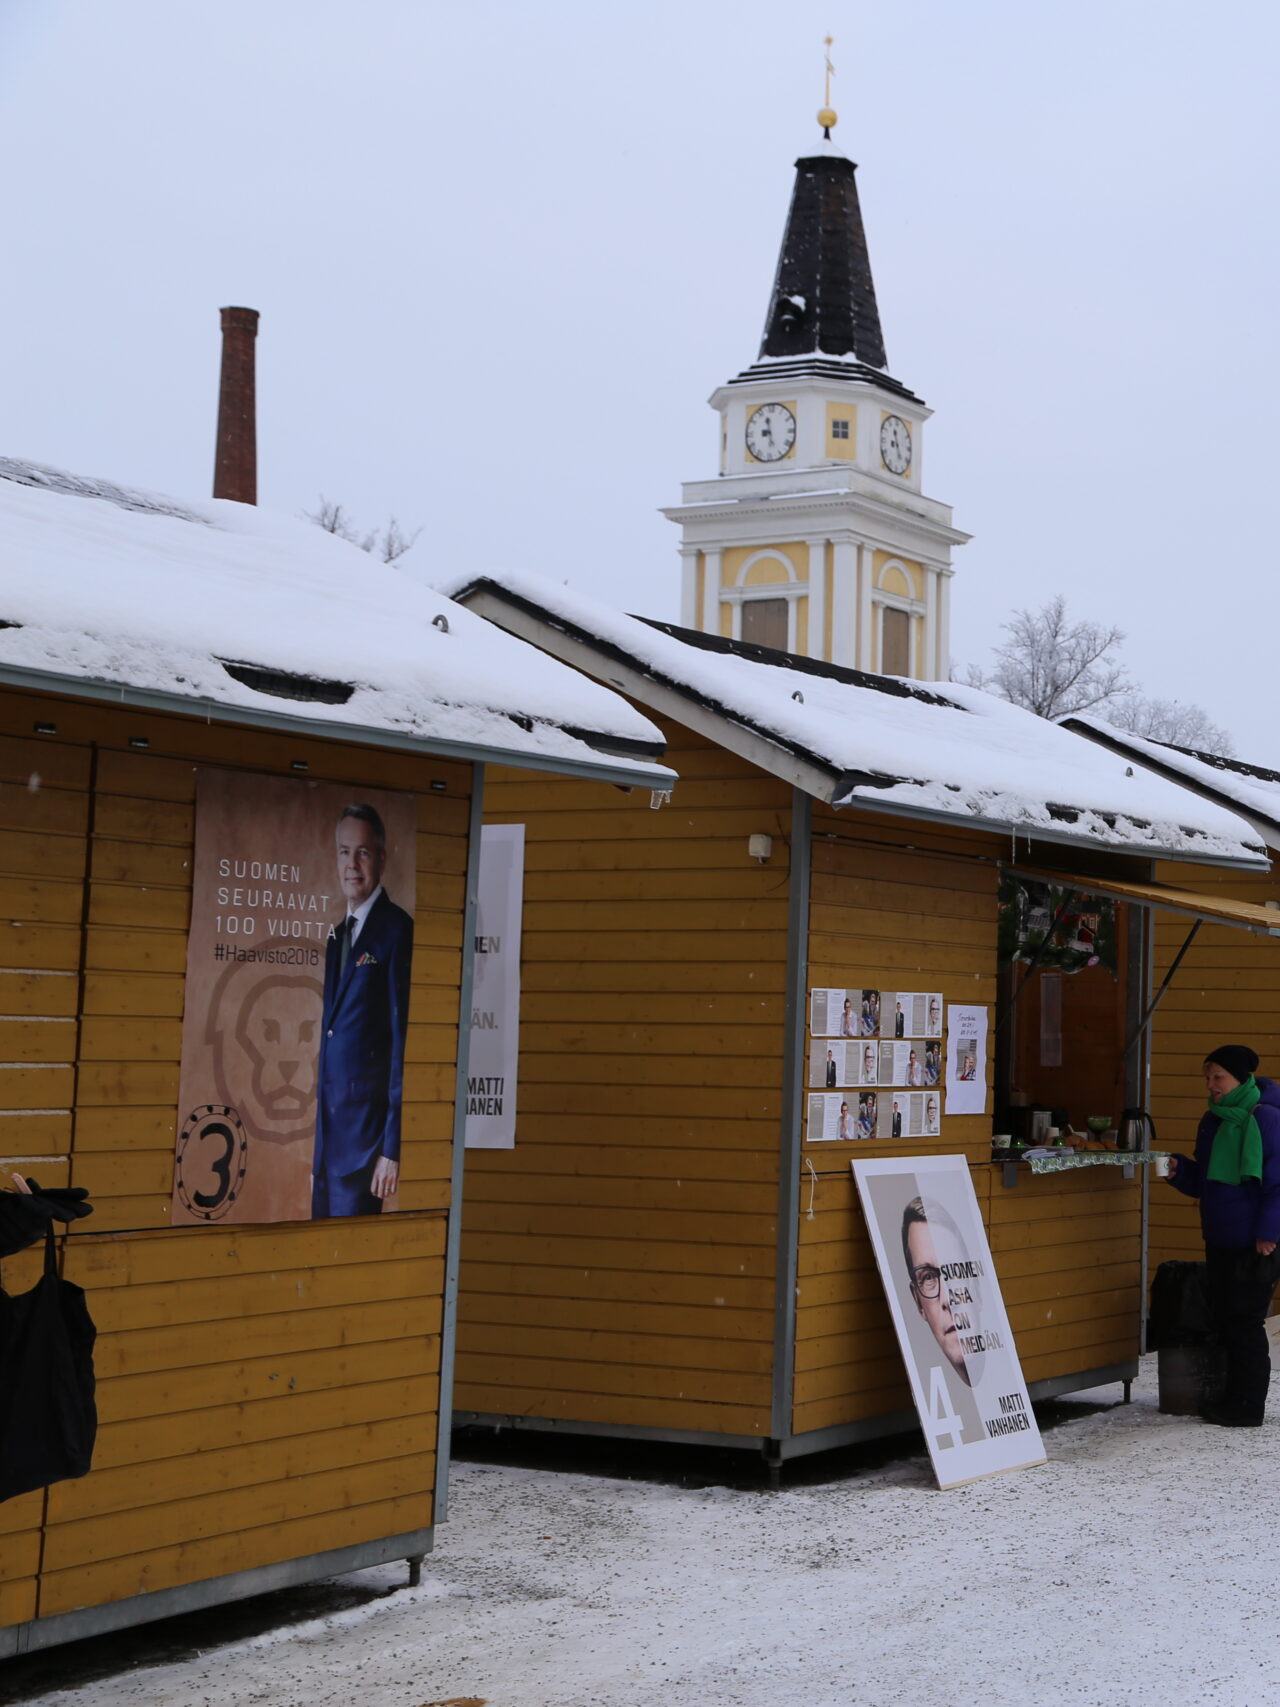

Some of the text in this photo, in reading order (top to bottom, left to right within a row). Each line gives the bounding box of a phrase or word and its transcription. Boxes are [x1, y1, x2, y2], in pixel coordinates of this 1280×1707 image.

[219, 859, 300, 883] SUOMEN
[217, 887, 330, 912] SEURAAVAT
[216, 916, 336, 940] 100 VUOTTA
[214, 943, 319, 966] #Haavisto2018
[467, 1077, 504, 1095] MATTI
[193, 1122, 235, 1208] 3
[940, 1260, 984, 1281] SUOMEN
[948, 1287, 974, 1306] ASIA
[953, 1312, 971, 1330] ON
[928, 1366, 964, 1451] 4
[998, 1392, 1025, 1414] MATTI
[985, 1412, 1031, 1438] VANHANEN
